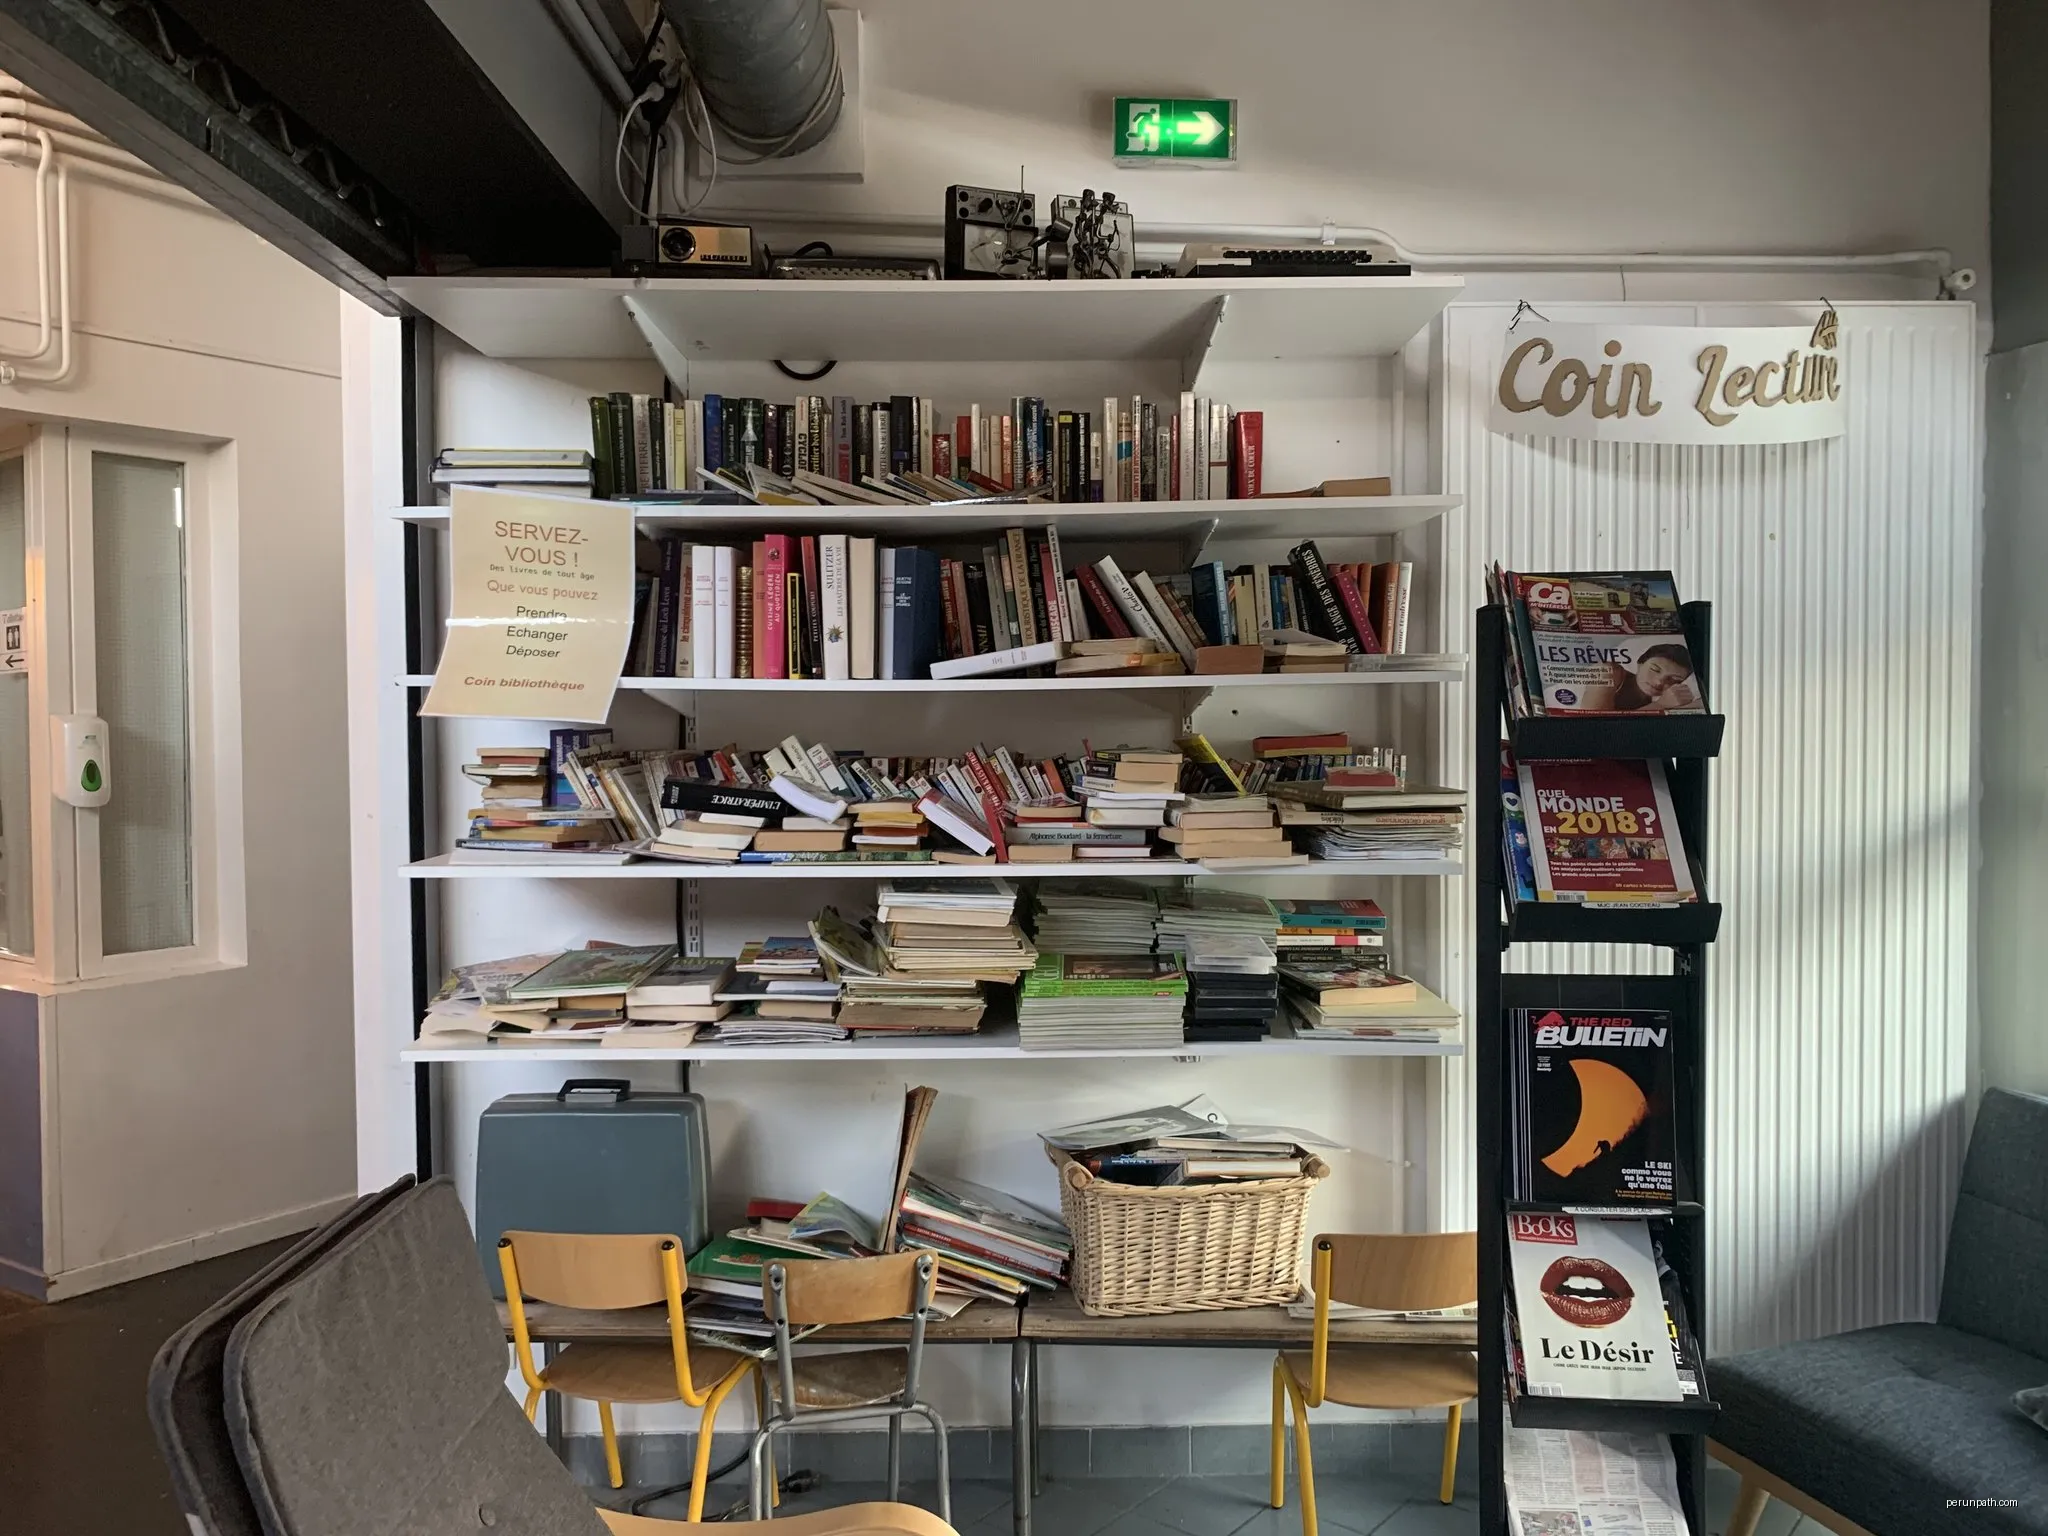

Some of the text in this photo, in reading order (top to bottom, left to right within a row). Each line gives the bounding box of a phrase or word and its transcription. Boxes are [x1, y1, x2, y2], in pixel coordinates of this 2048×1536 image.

[1499, 337, 1662, 419] Coin
[638, 440, 650, 474] PIERRE
[1014, 440, 1023, 484] PORTUGAIS
[495, 521, 588, 545] SERVEZ-
[505, 546, 567, 566] VOUS
[490, 564, 504, 572] Des
[510, 564, 538, 575] livres
[542, 568, 552, 577] de
[557, 570, 576, 578] tout
[826, 546, 834, 590] SULITZER
[1302, 550, 1327, 589] TÉNÈBRES
[487, 580, 599, 601] Que vous pouvez
[1012, 533, 1033, 640] TOURISTIQUE DE LA FRANCE
[1320, 588, 1334, 606] DES
[516, 606, 568, 621] Prendre
[774, 613, 780, 622] AU
[1326, 604, 1347, 634] L'ANGE
[506, 626, 568, 642] Echanger
[506, 645, 560, 659] Déposer
[1539, 644, 1632, 665] LES RÊVES
[464, 676, 585, 692] Coin bibliothèque
[711, 794, 781, 810] L'IMPÉRATRICE
[1537, 789, 1570, 799] QUEL
[1540, 797, 1624, 814] MONDE
[1544, 826, 1557, 834] EN
[1556, 811, 1639, 834] 2018
[1029, 832, 1056, 840] Alphonse
[1570, 1017, 1632, 1027] THE RED
[1657, 1162, 1672, 1170] SKI
[1656, 1182, 1672, 1190] fois
[1540, 1338, 1654, 1364] Le Désir
